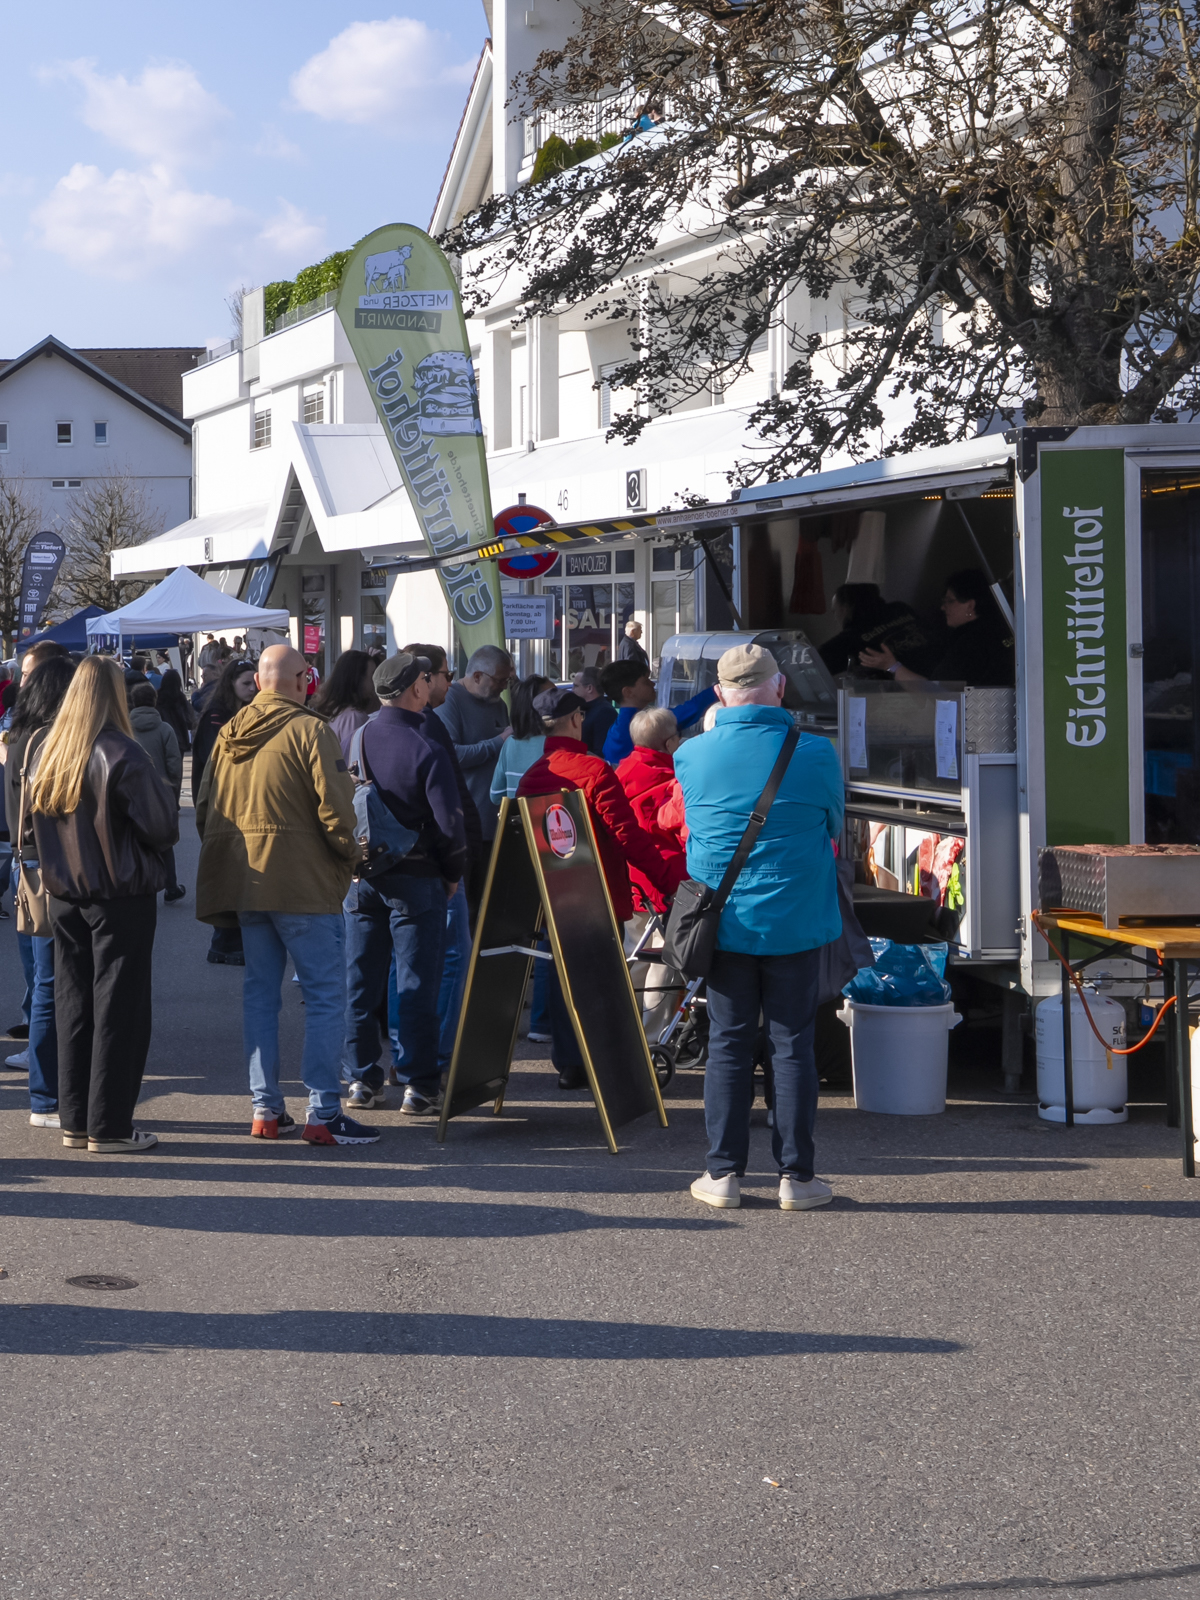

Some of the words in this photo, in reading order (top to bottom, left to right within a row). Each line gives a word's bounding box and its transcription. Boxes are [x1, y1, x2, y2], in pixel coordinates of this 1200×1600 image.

[557, 489, 568, 511] 46
[570, 555, 607, 573] BANHOLZER
[24, 603, 37, 612] FIAT
[1062, 506, 1106, 747] Eichrüttehof
